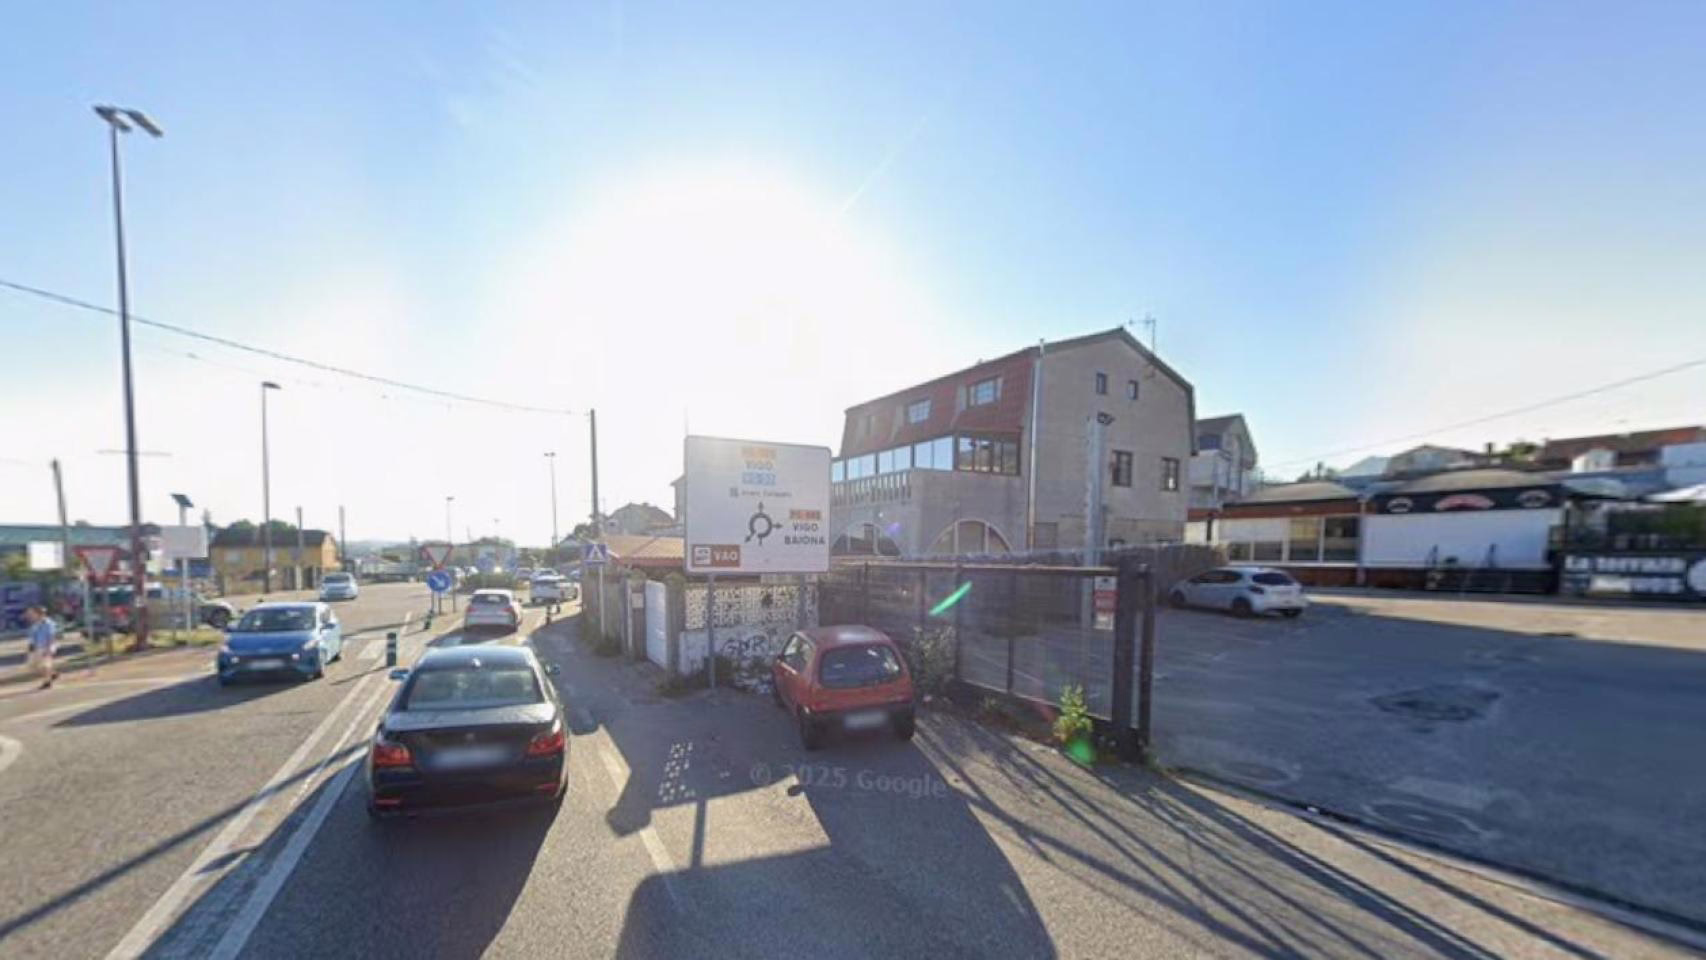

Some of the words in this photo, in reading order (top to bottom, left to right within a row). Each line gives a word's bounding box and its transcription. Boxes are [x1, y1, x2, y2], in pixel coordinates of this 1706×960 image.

[793, 523, 819, 532] VIGO
[784, 534, 826, 546] BAIONA
[713, 550, 738, 561] VAO
